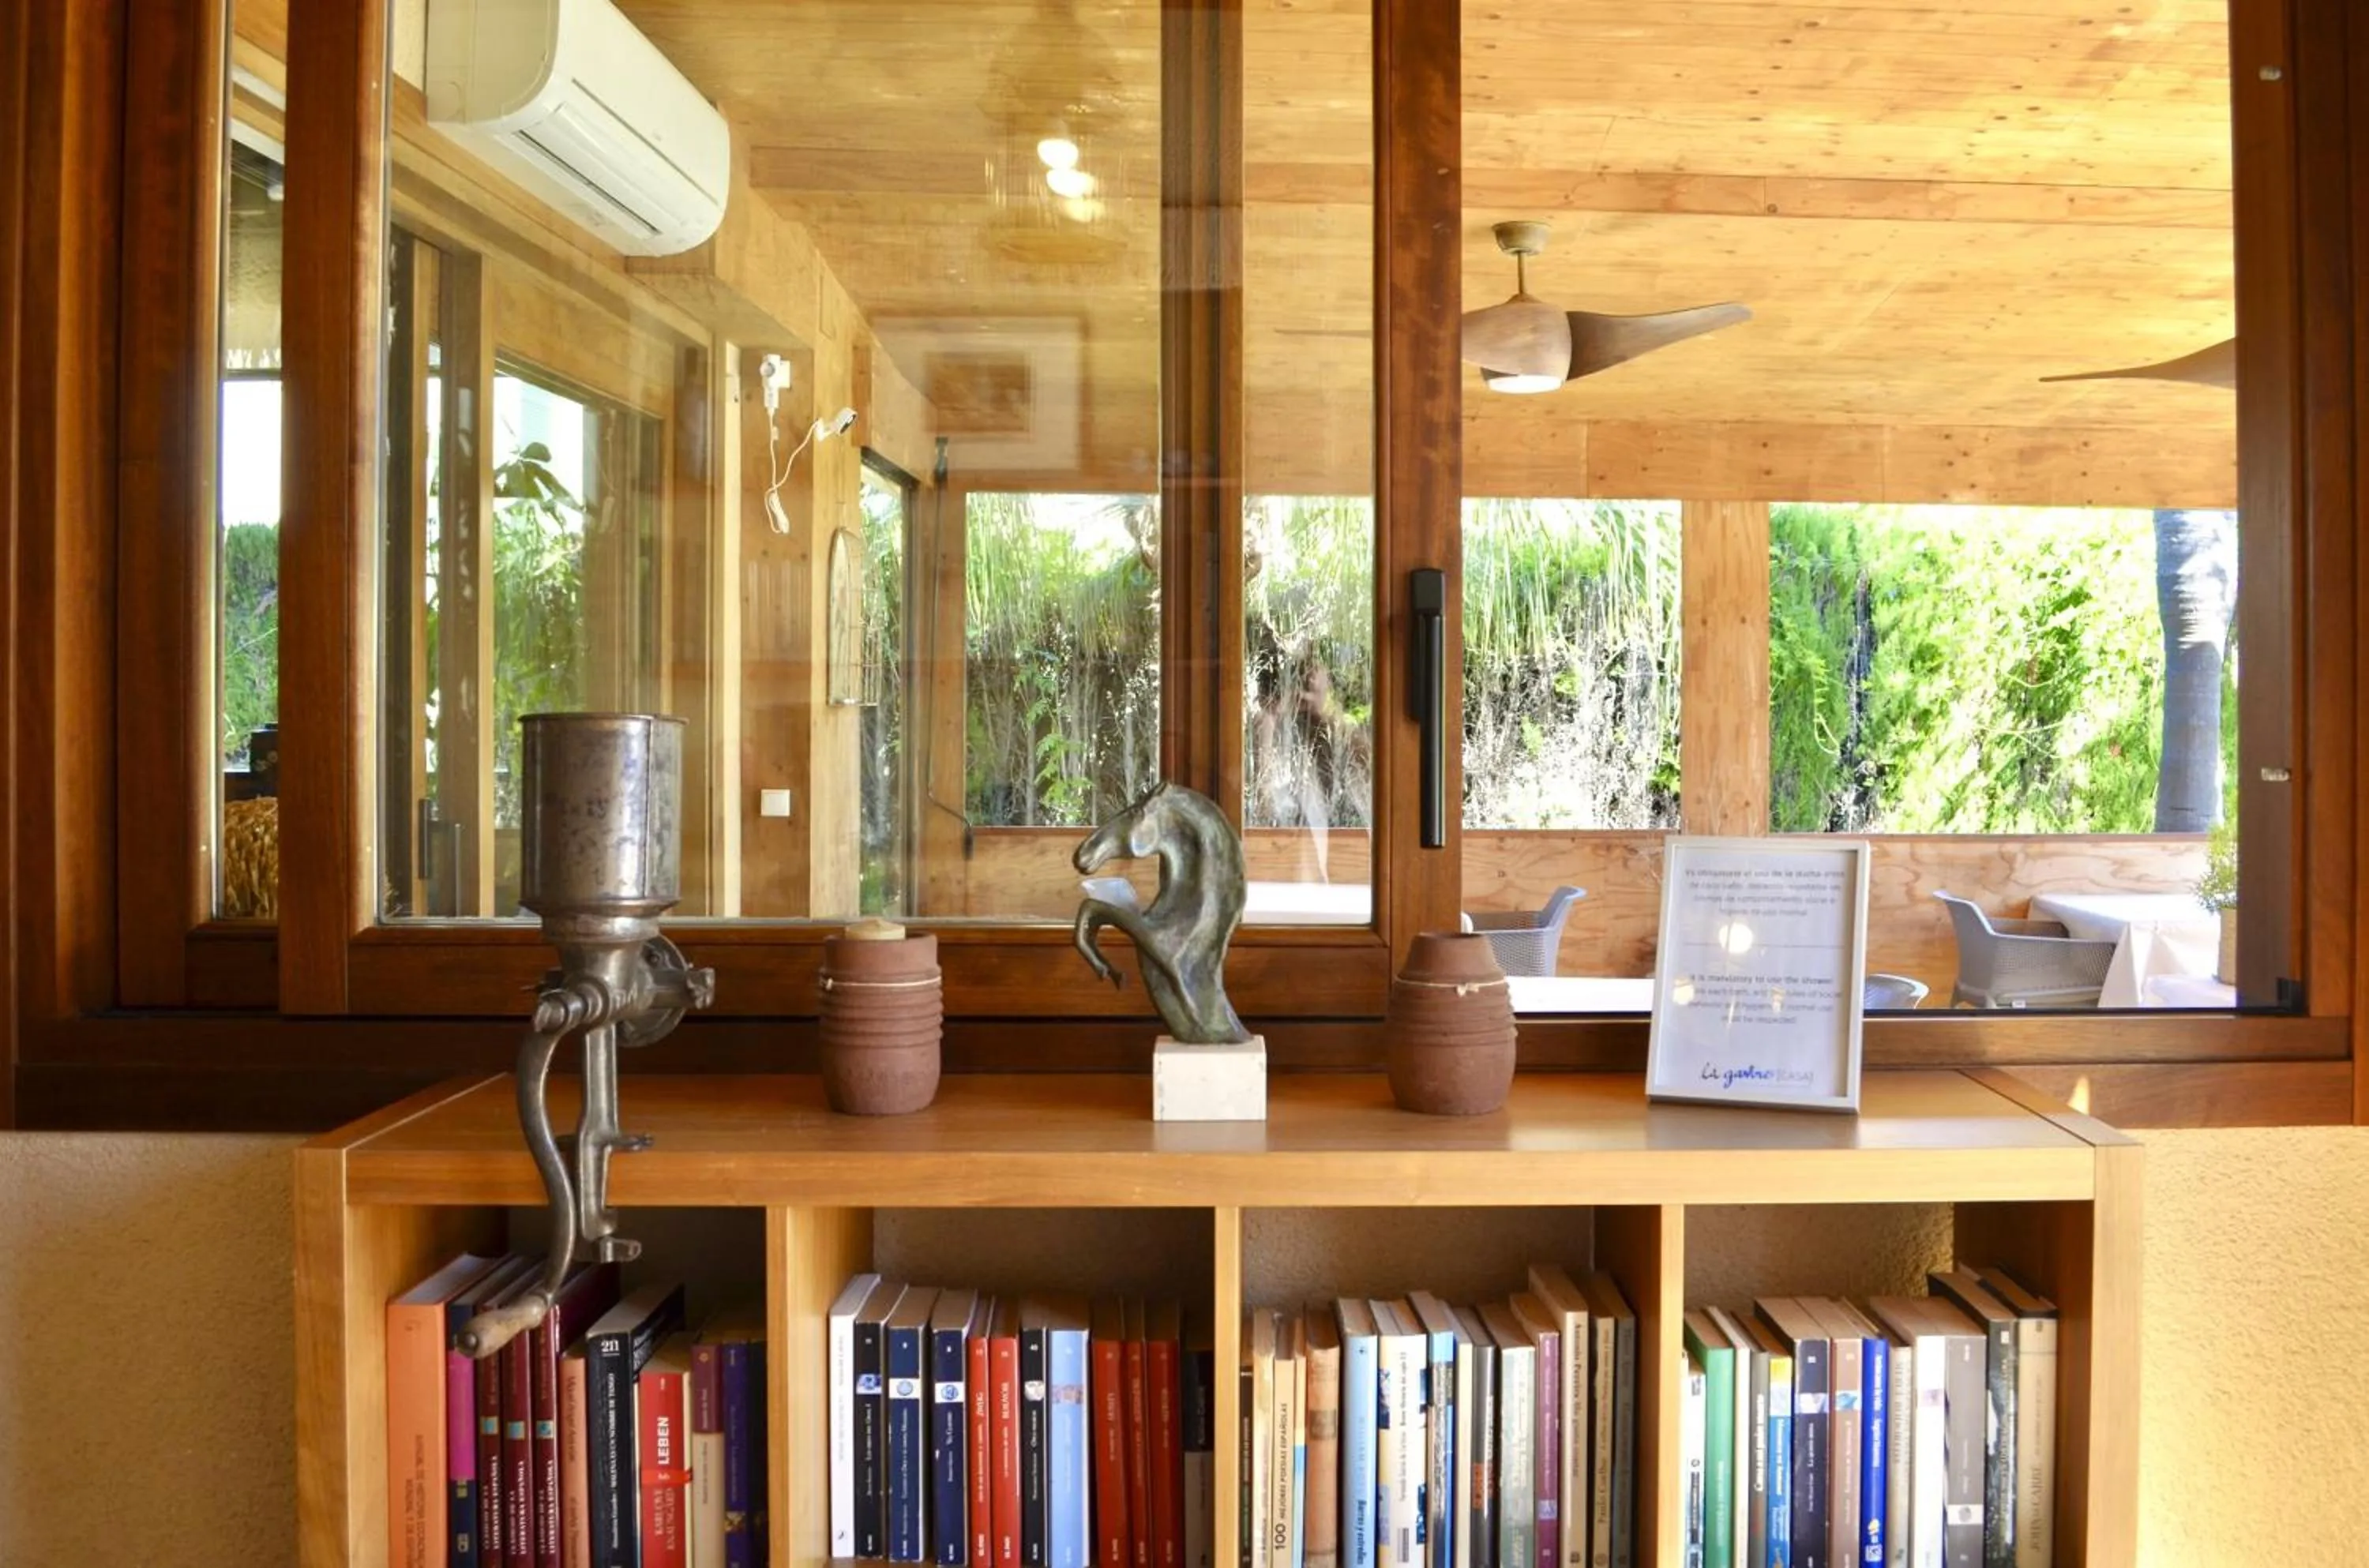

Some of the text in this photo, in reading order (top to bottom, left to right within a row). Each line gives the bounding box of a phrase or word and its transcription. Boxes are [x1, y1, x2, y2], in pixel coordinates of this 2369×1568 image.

[656, 1416, 670, 1465] LEBEN
[1278, 1403, 1289, 1450] ESPAÑOLAS
[1278, 1484, 1288, 1519] MEJORES
[1275, 1523, 1287, 1551] 100
